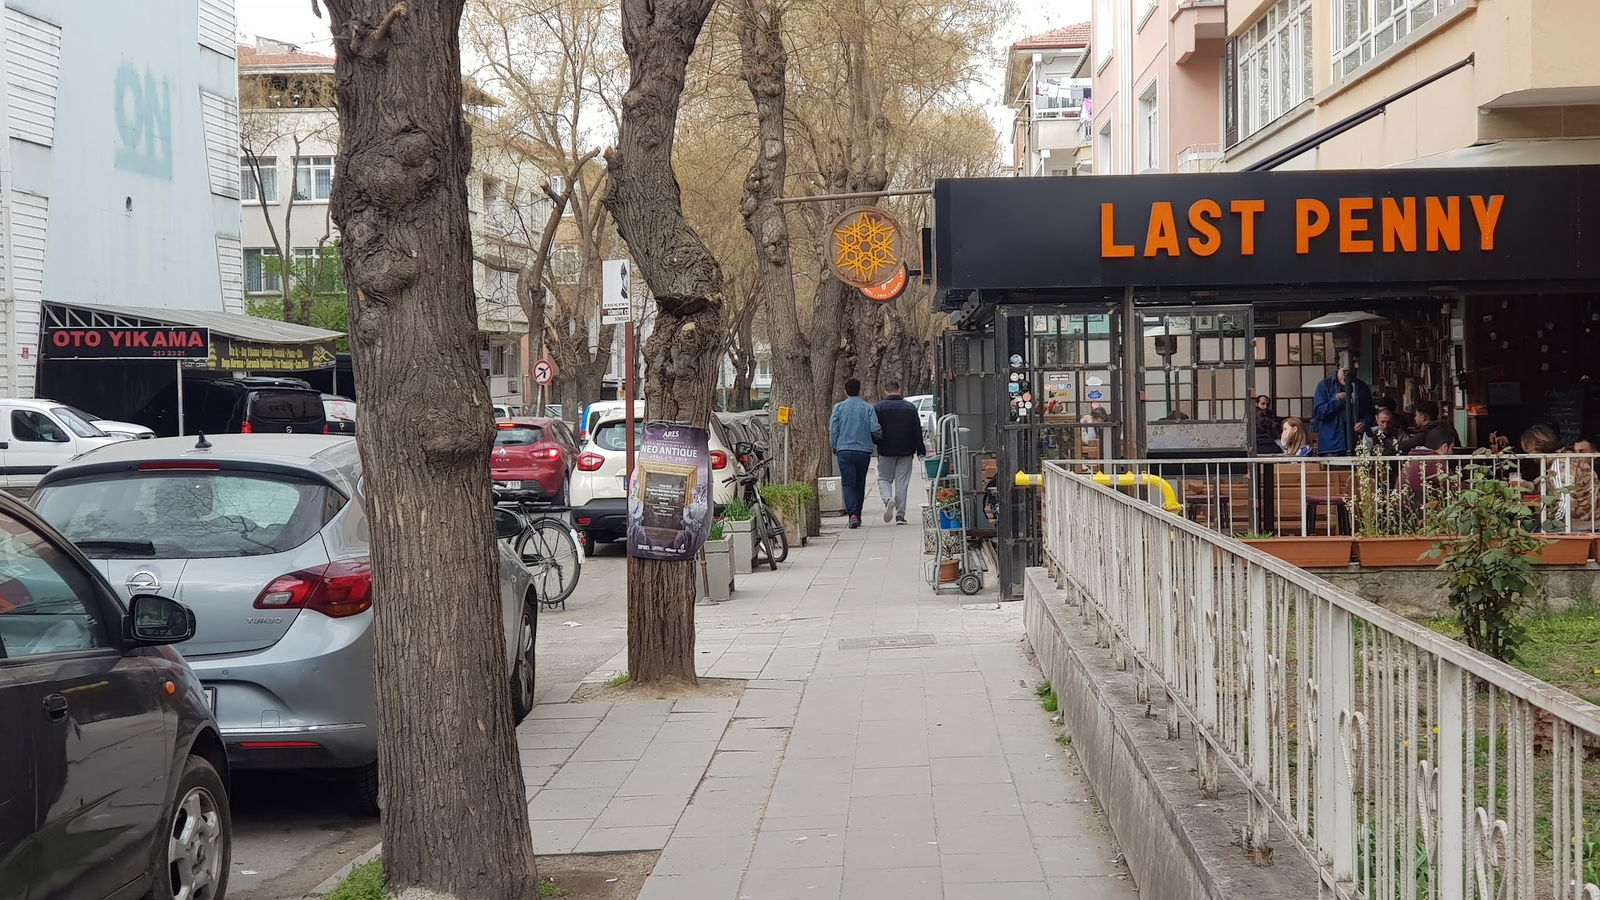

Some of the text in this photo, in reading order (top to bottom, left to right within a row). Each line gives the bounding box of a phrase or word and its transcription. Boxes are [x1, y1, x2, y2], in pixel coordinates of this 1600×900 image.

[1100, 195, 1505, 258] LAST PENNY
[53, 330, 204, 347] OTO YIKAMA
[662, 430, 680, 438] ARES
[641, 444, 698, 458] NEO ANTIQUE
[245, 616, 283, 625] TURBO
